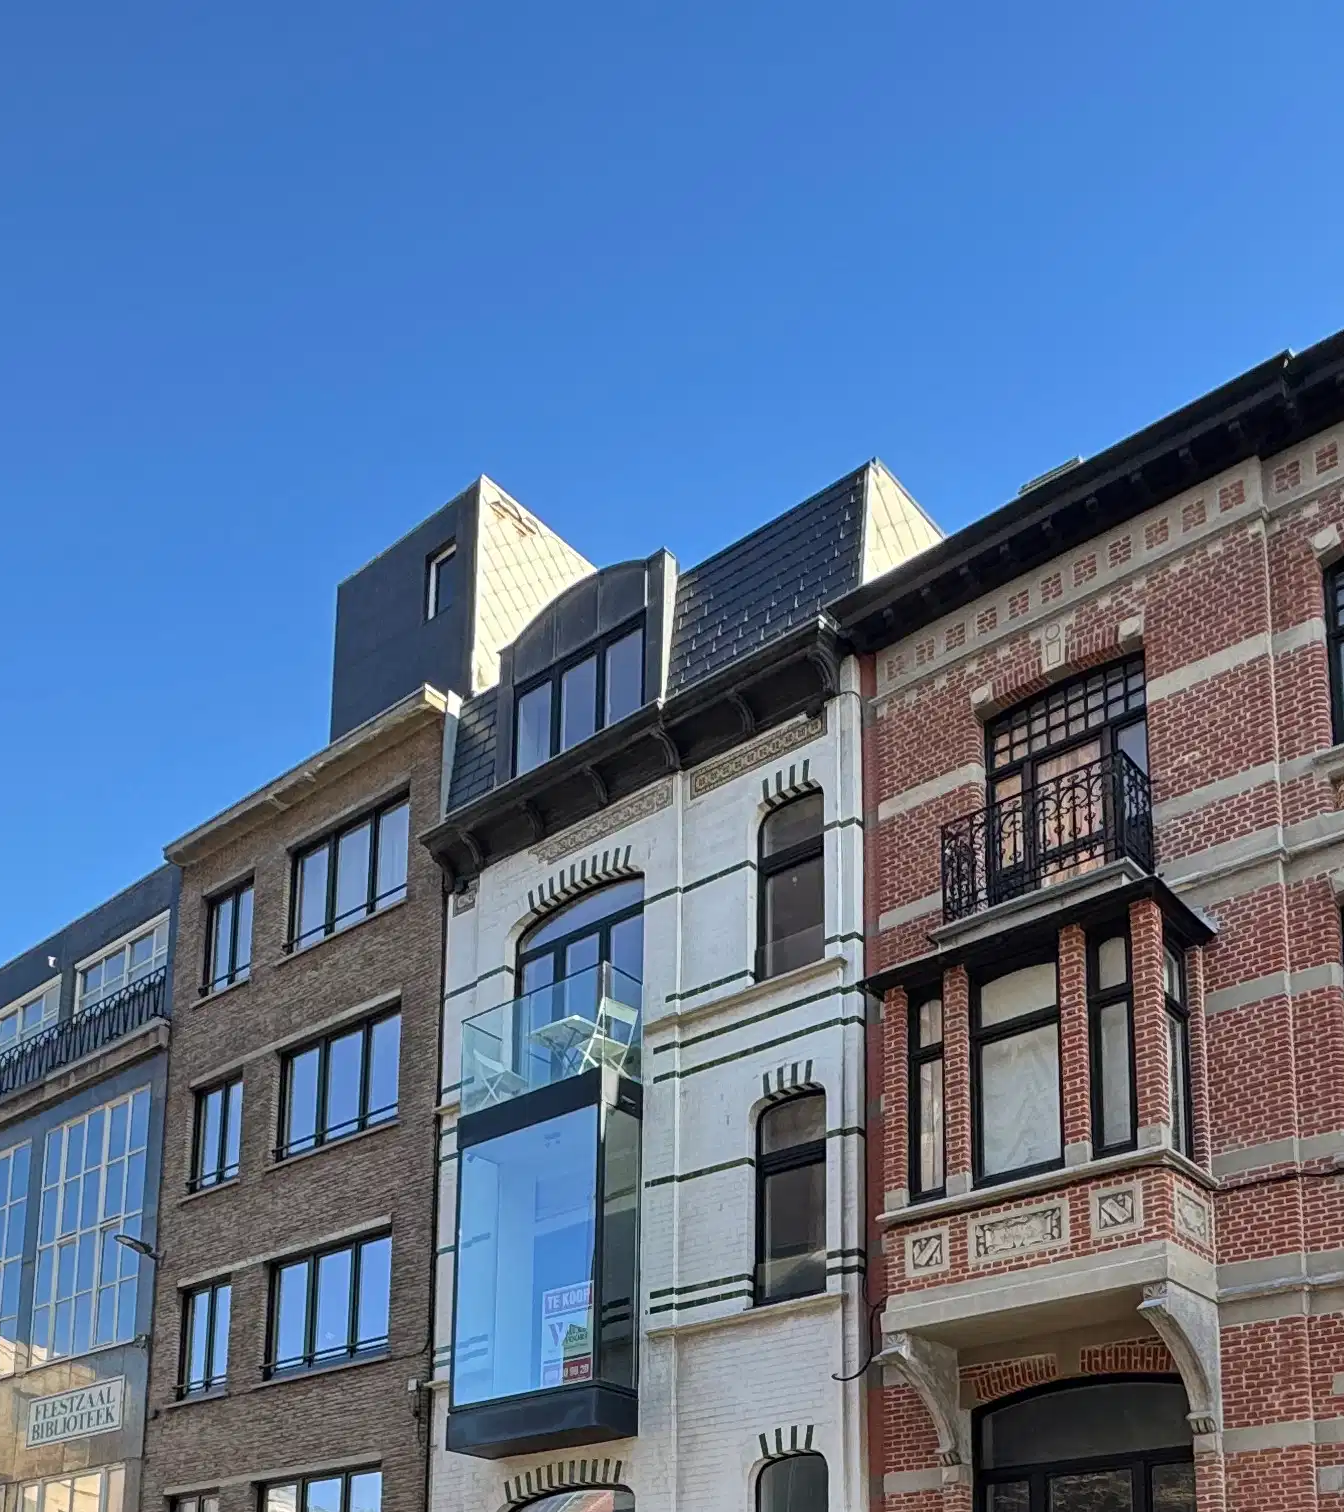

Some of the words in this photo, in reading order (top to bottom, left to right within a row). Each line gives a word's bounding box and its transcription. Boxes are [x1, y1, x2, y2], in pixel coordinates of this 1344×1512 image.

[547, 1294, 561, 1310] TE
[35, 1386, 116, 1421] FEESTZAAL
[31, 1404, 116, 1441] BIBLIOTEEK
